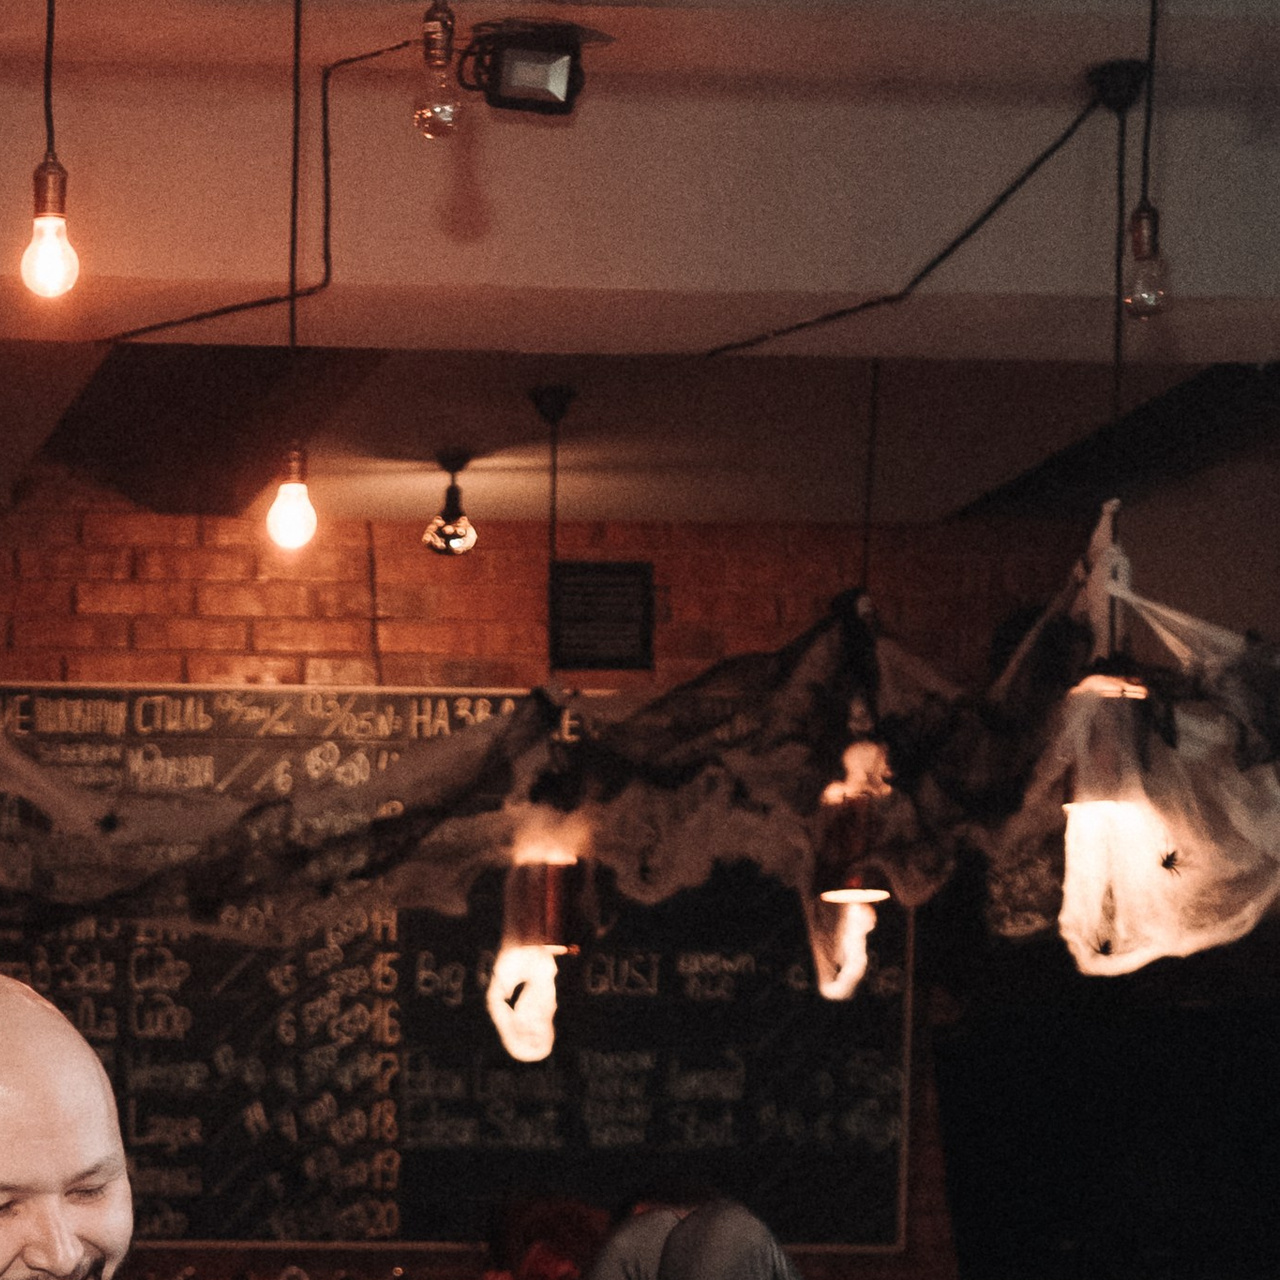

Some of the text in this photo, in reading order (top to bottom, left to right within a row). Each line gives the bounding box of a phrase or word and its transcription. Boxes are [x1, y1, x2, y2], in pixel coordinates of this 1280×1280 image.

[135, 694, 214, 735] СТИЛЬ
[410, 697, 580, 742] НАЗВЕ
[370, 997, 402, 1044] 16
[370, 1098, 400, 1142] 18
[372, 1147, 402, 1189] 19
[365, 1199, 401, 1238] 20
